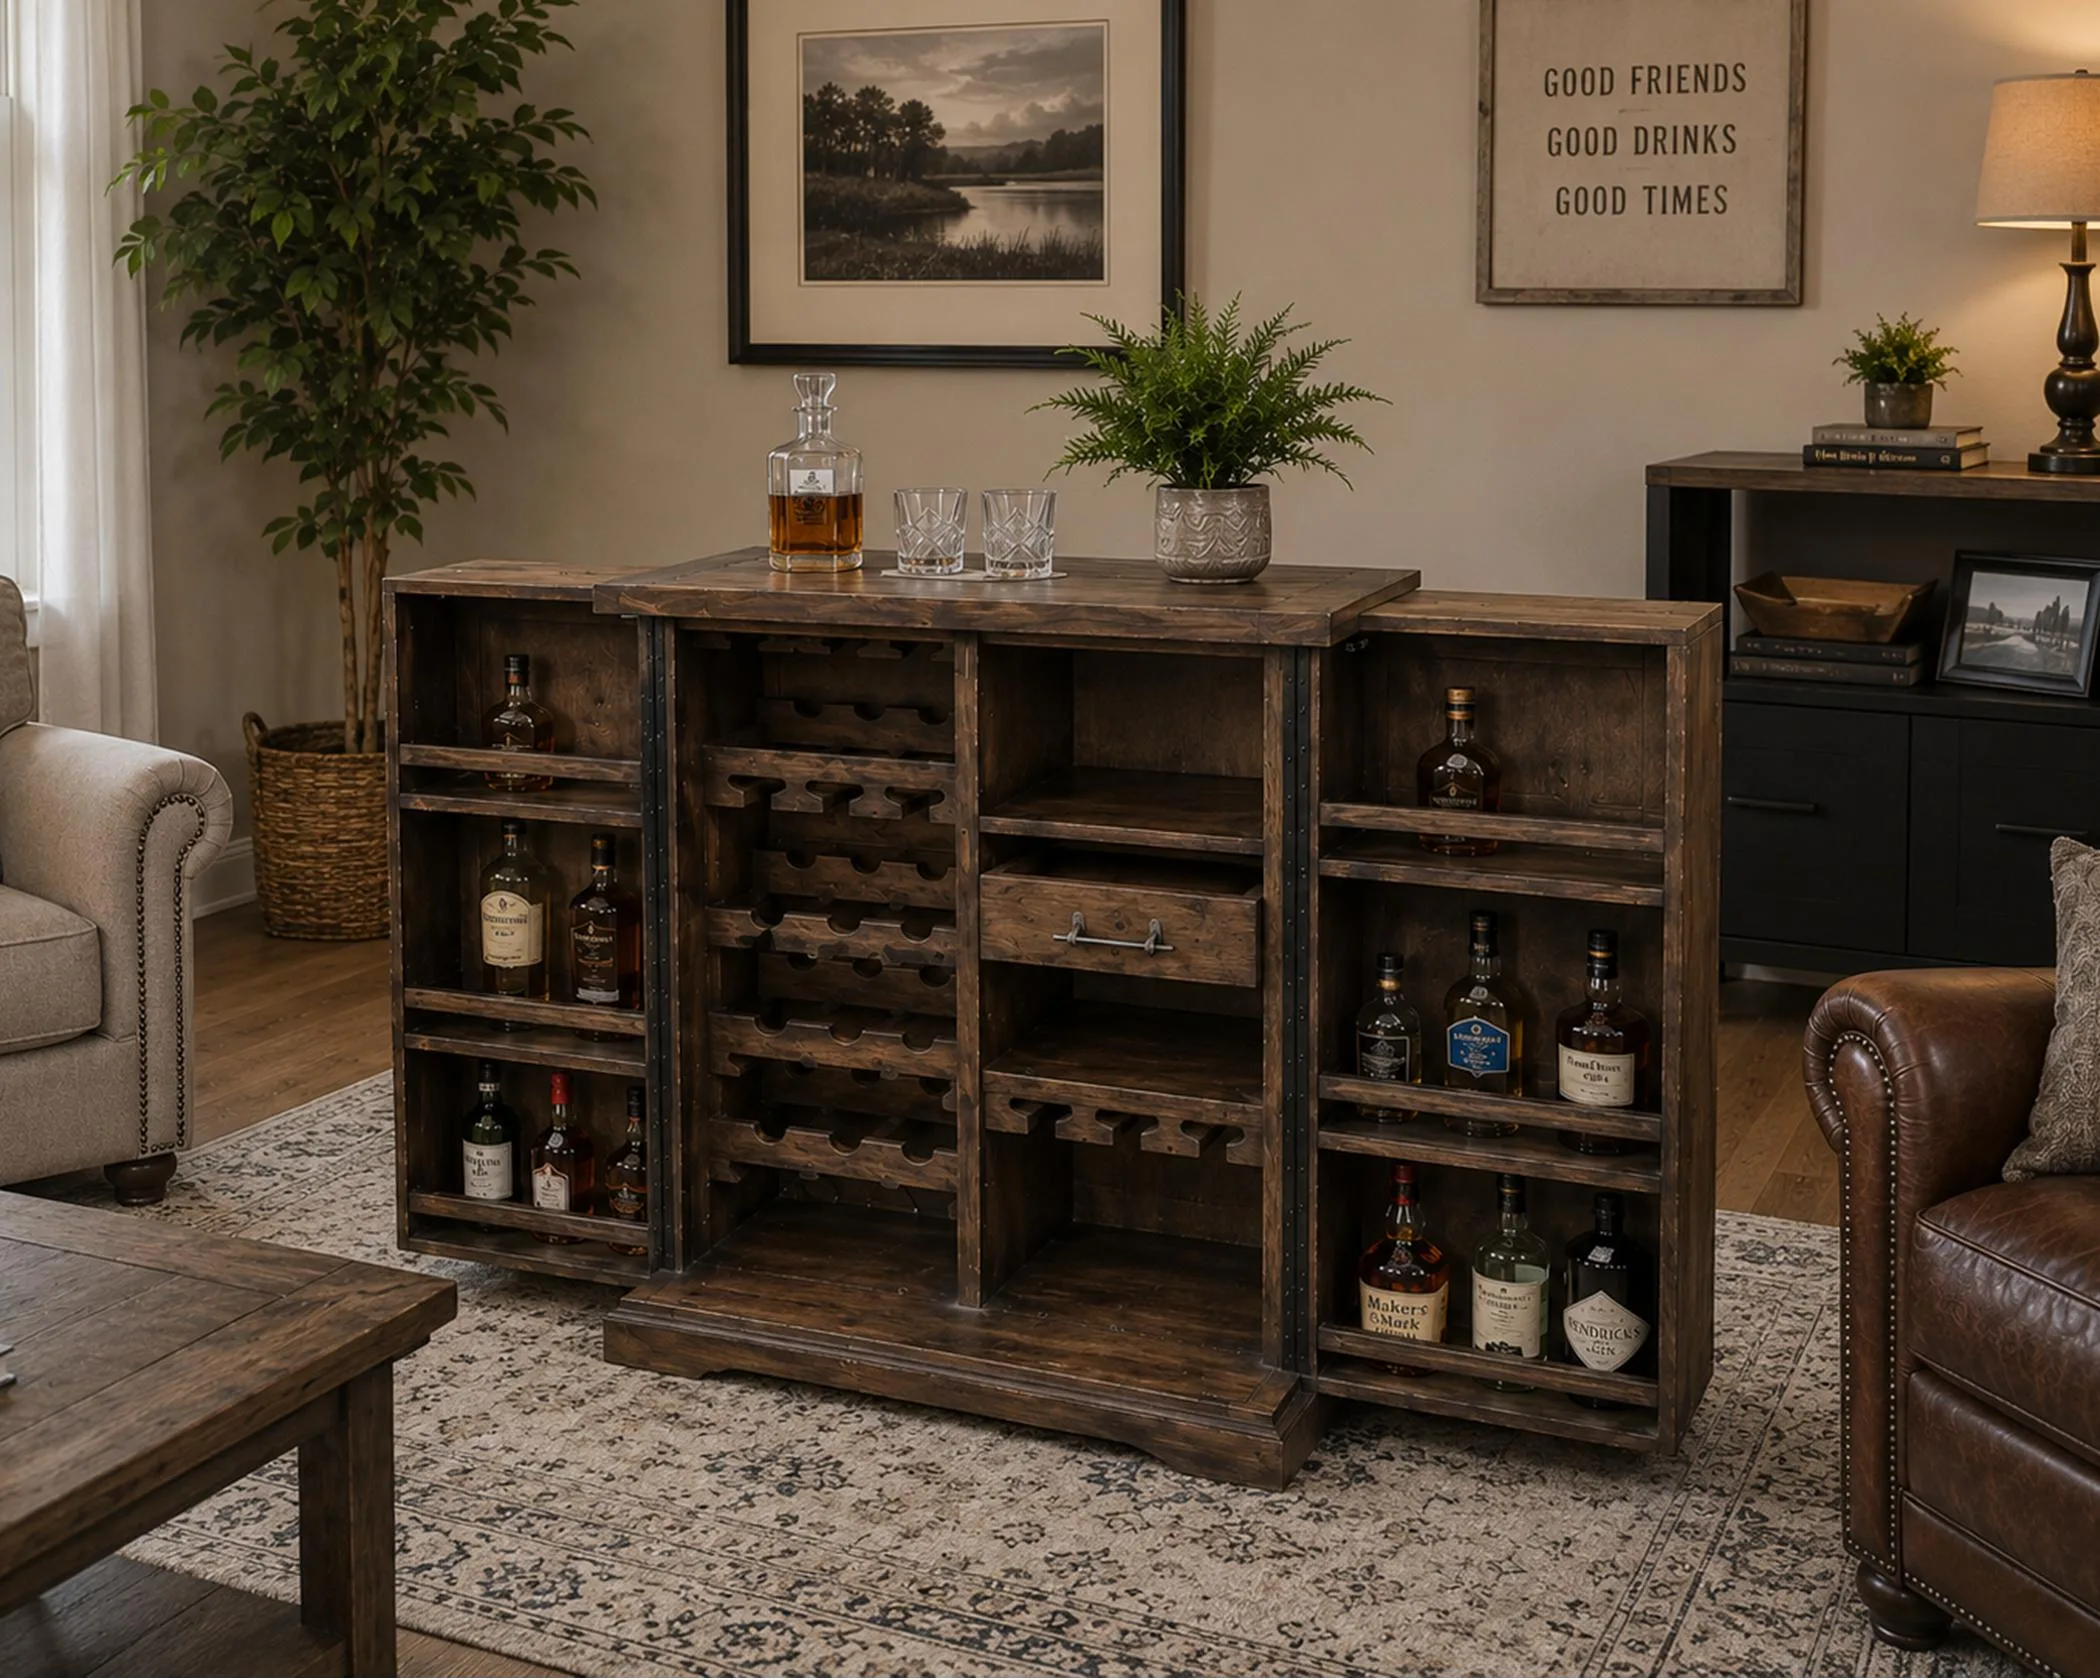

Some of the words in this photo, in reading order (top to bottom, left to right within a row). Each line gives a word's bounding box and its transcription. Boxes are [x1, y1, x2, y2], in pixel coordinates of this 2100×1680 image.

[1544, 66, 1615, 98] GOOD
[1631, 62, 1747, 96] FRIENDS
[1547, 127, 1618, 158] GOOD
[1634, 123, 1737, 156] DRINKS
[1555, 185, 1627, 216] GOOD
[1642, 184, 1729, 216] TIMES
